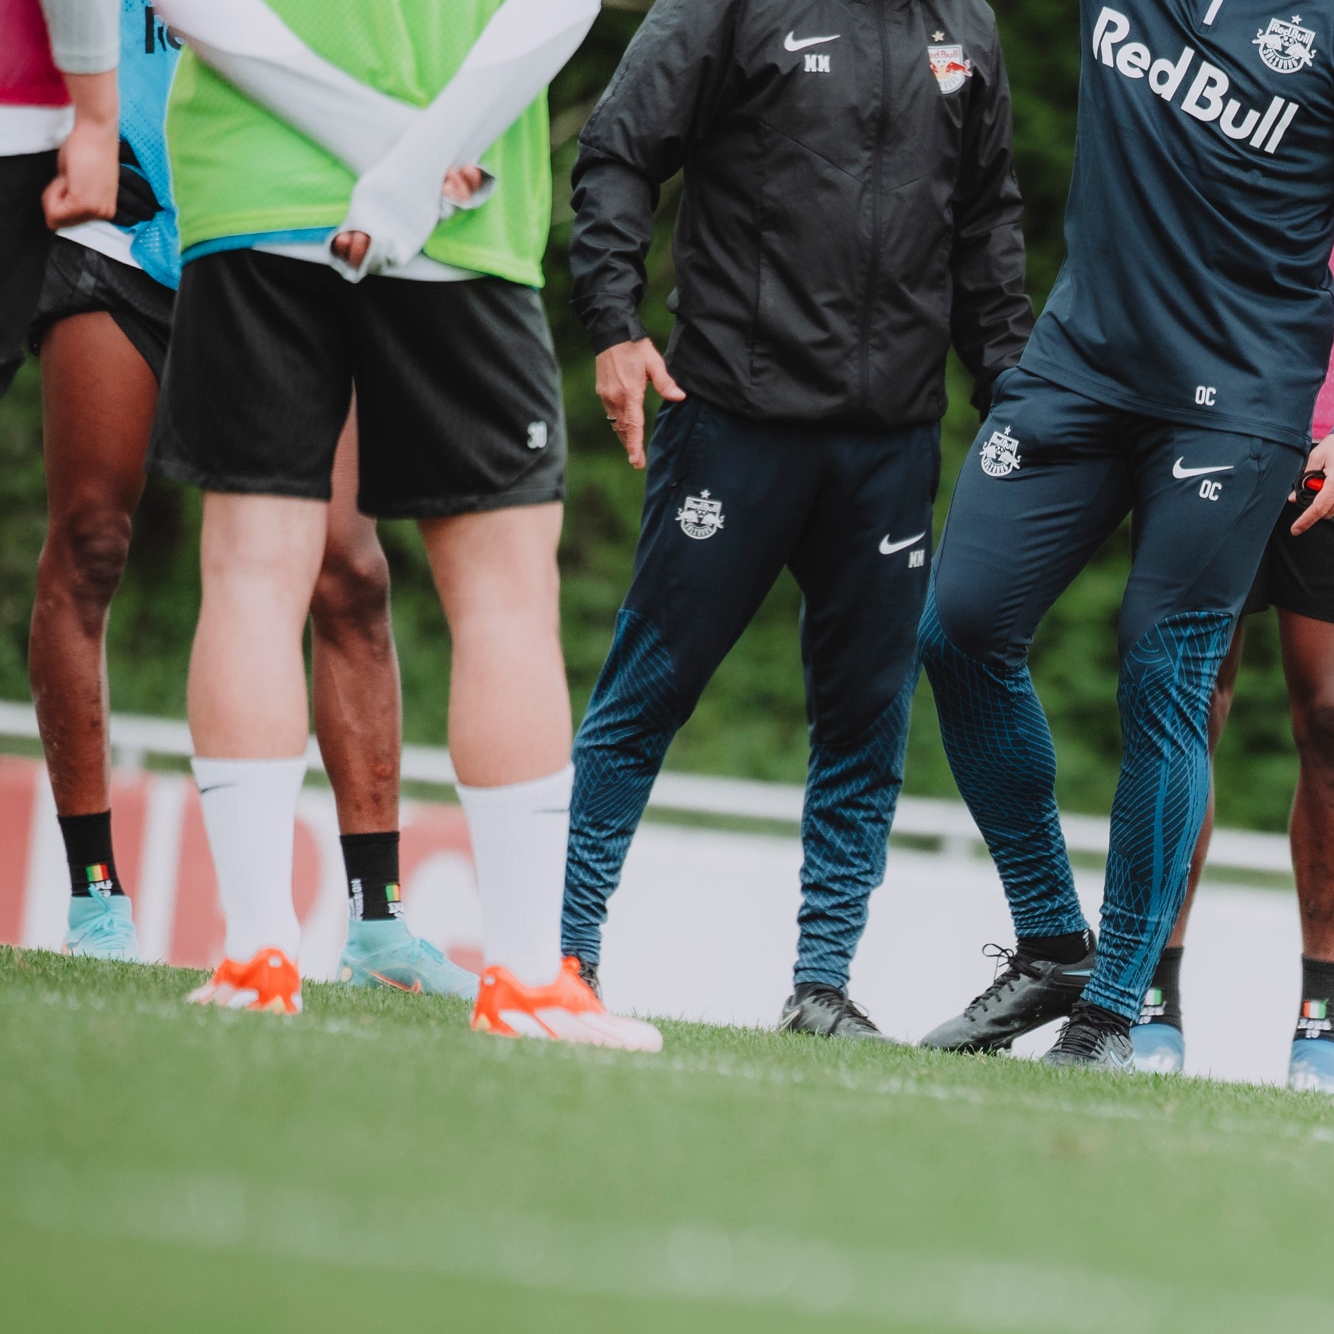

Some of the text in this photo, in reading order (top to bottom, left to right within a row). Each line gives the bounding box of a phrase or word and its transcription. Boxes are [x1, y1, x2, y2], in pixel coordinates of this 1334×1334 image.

[803, 54, 831, 73] MM
[1092, 5, 1300, 155] Red Bull
[1195, 385, 1217, 406] OC
[1199, 479, 1222, 501] OC
